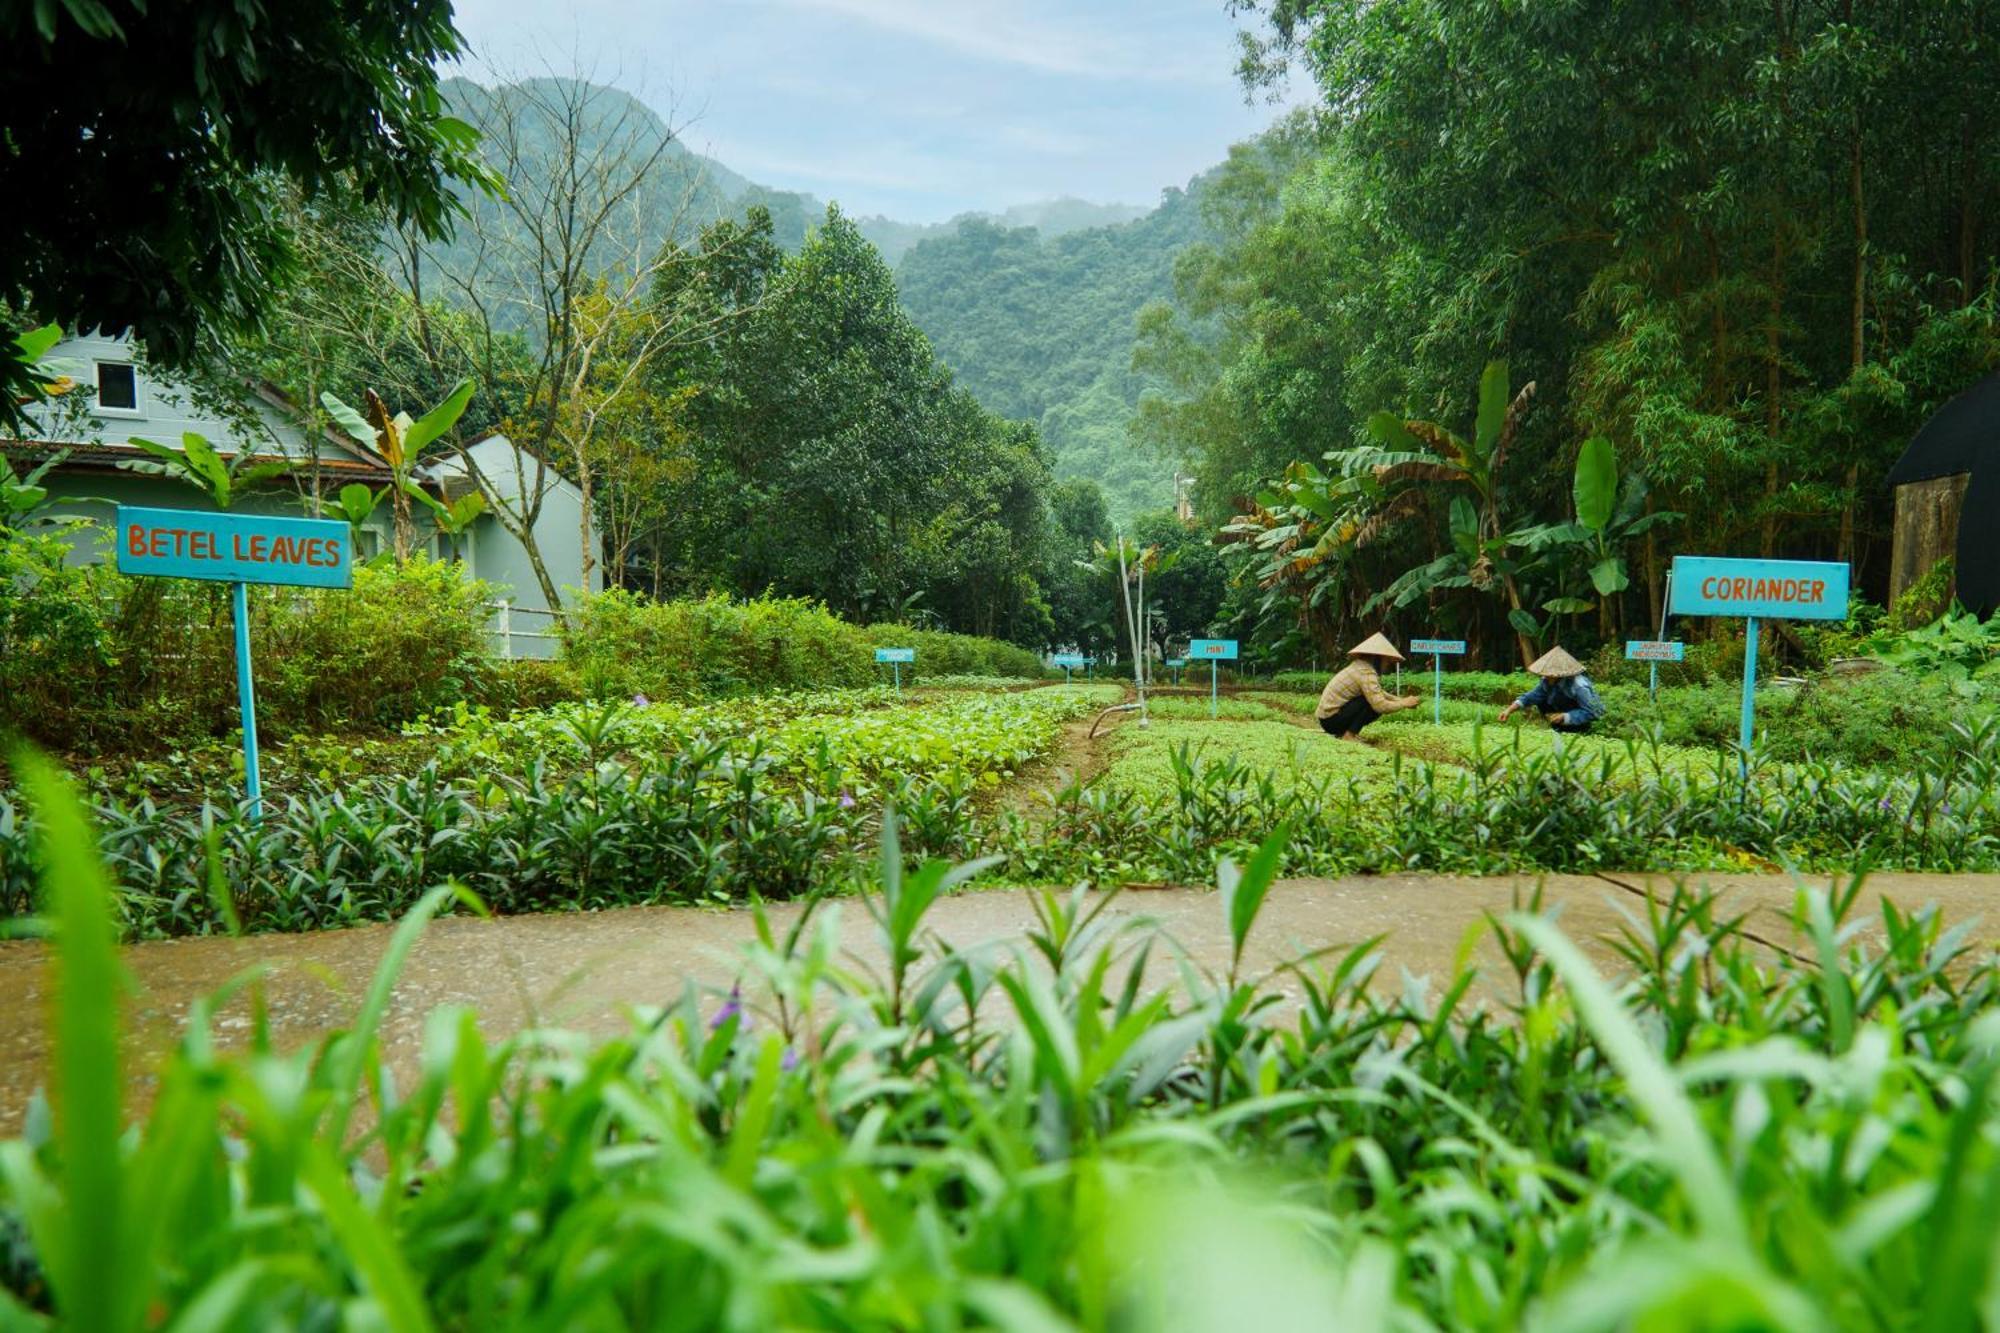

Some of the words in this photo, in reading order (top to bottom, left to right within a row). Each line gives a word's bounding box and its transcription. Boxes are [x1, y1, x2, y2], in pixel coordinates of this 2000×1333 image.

[128, 524, 224, 560] BETEL
[233, 533, 340, 568] LEAVES
[1701, 576, 1825, 603] CORIANDER
